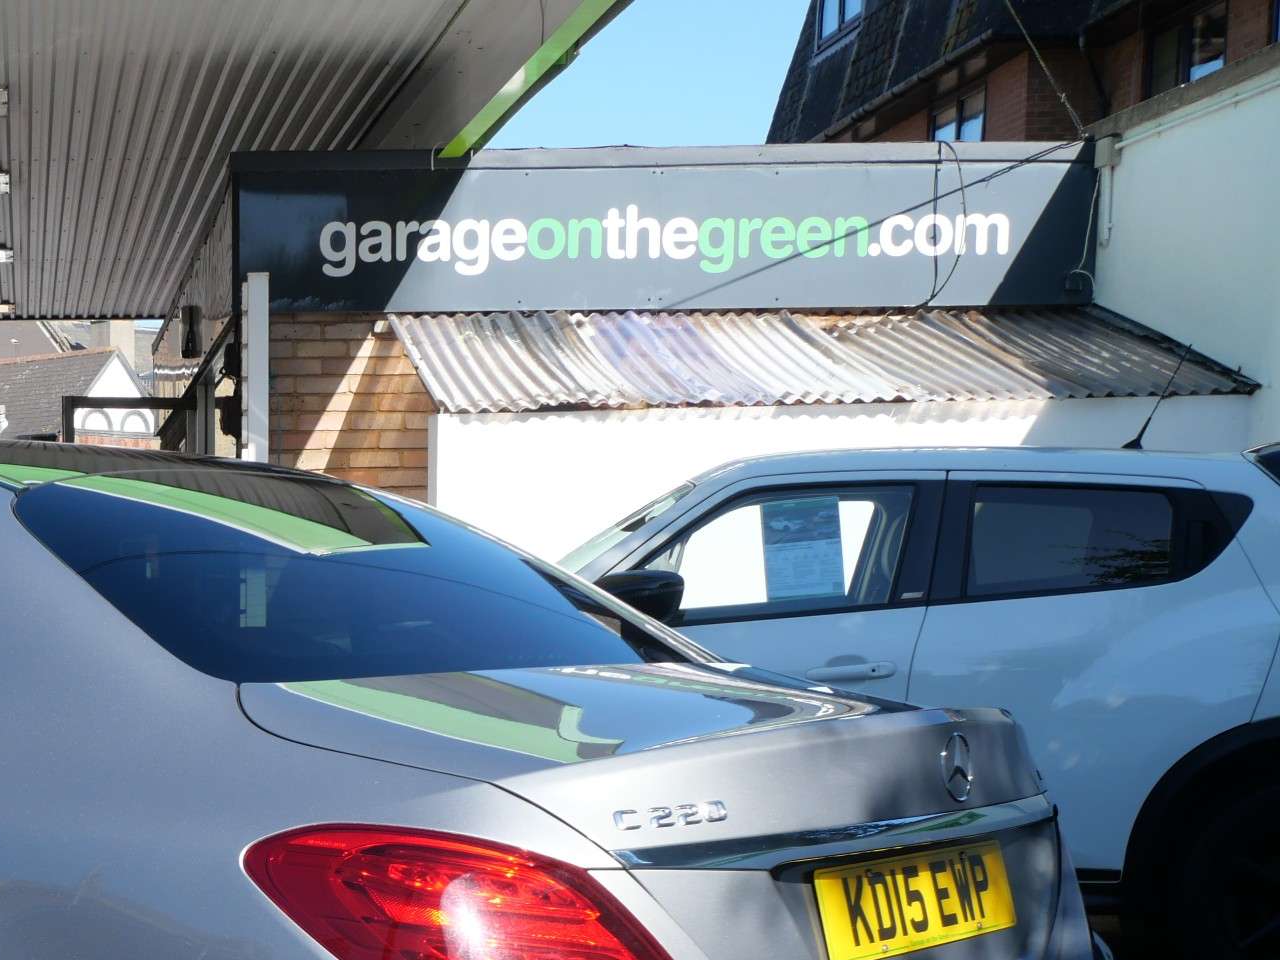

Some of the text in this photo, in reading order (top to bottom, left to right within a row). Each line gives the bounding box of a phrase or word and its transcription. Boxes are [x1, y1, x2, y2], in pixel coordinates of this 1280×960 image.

[320, 204, 1010, 277] garageonthegreen.com
[613, 800, 728, 830] C 220
[842, 853, 989, 946] KD15 EWP
